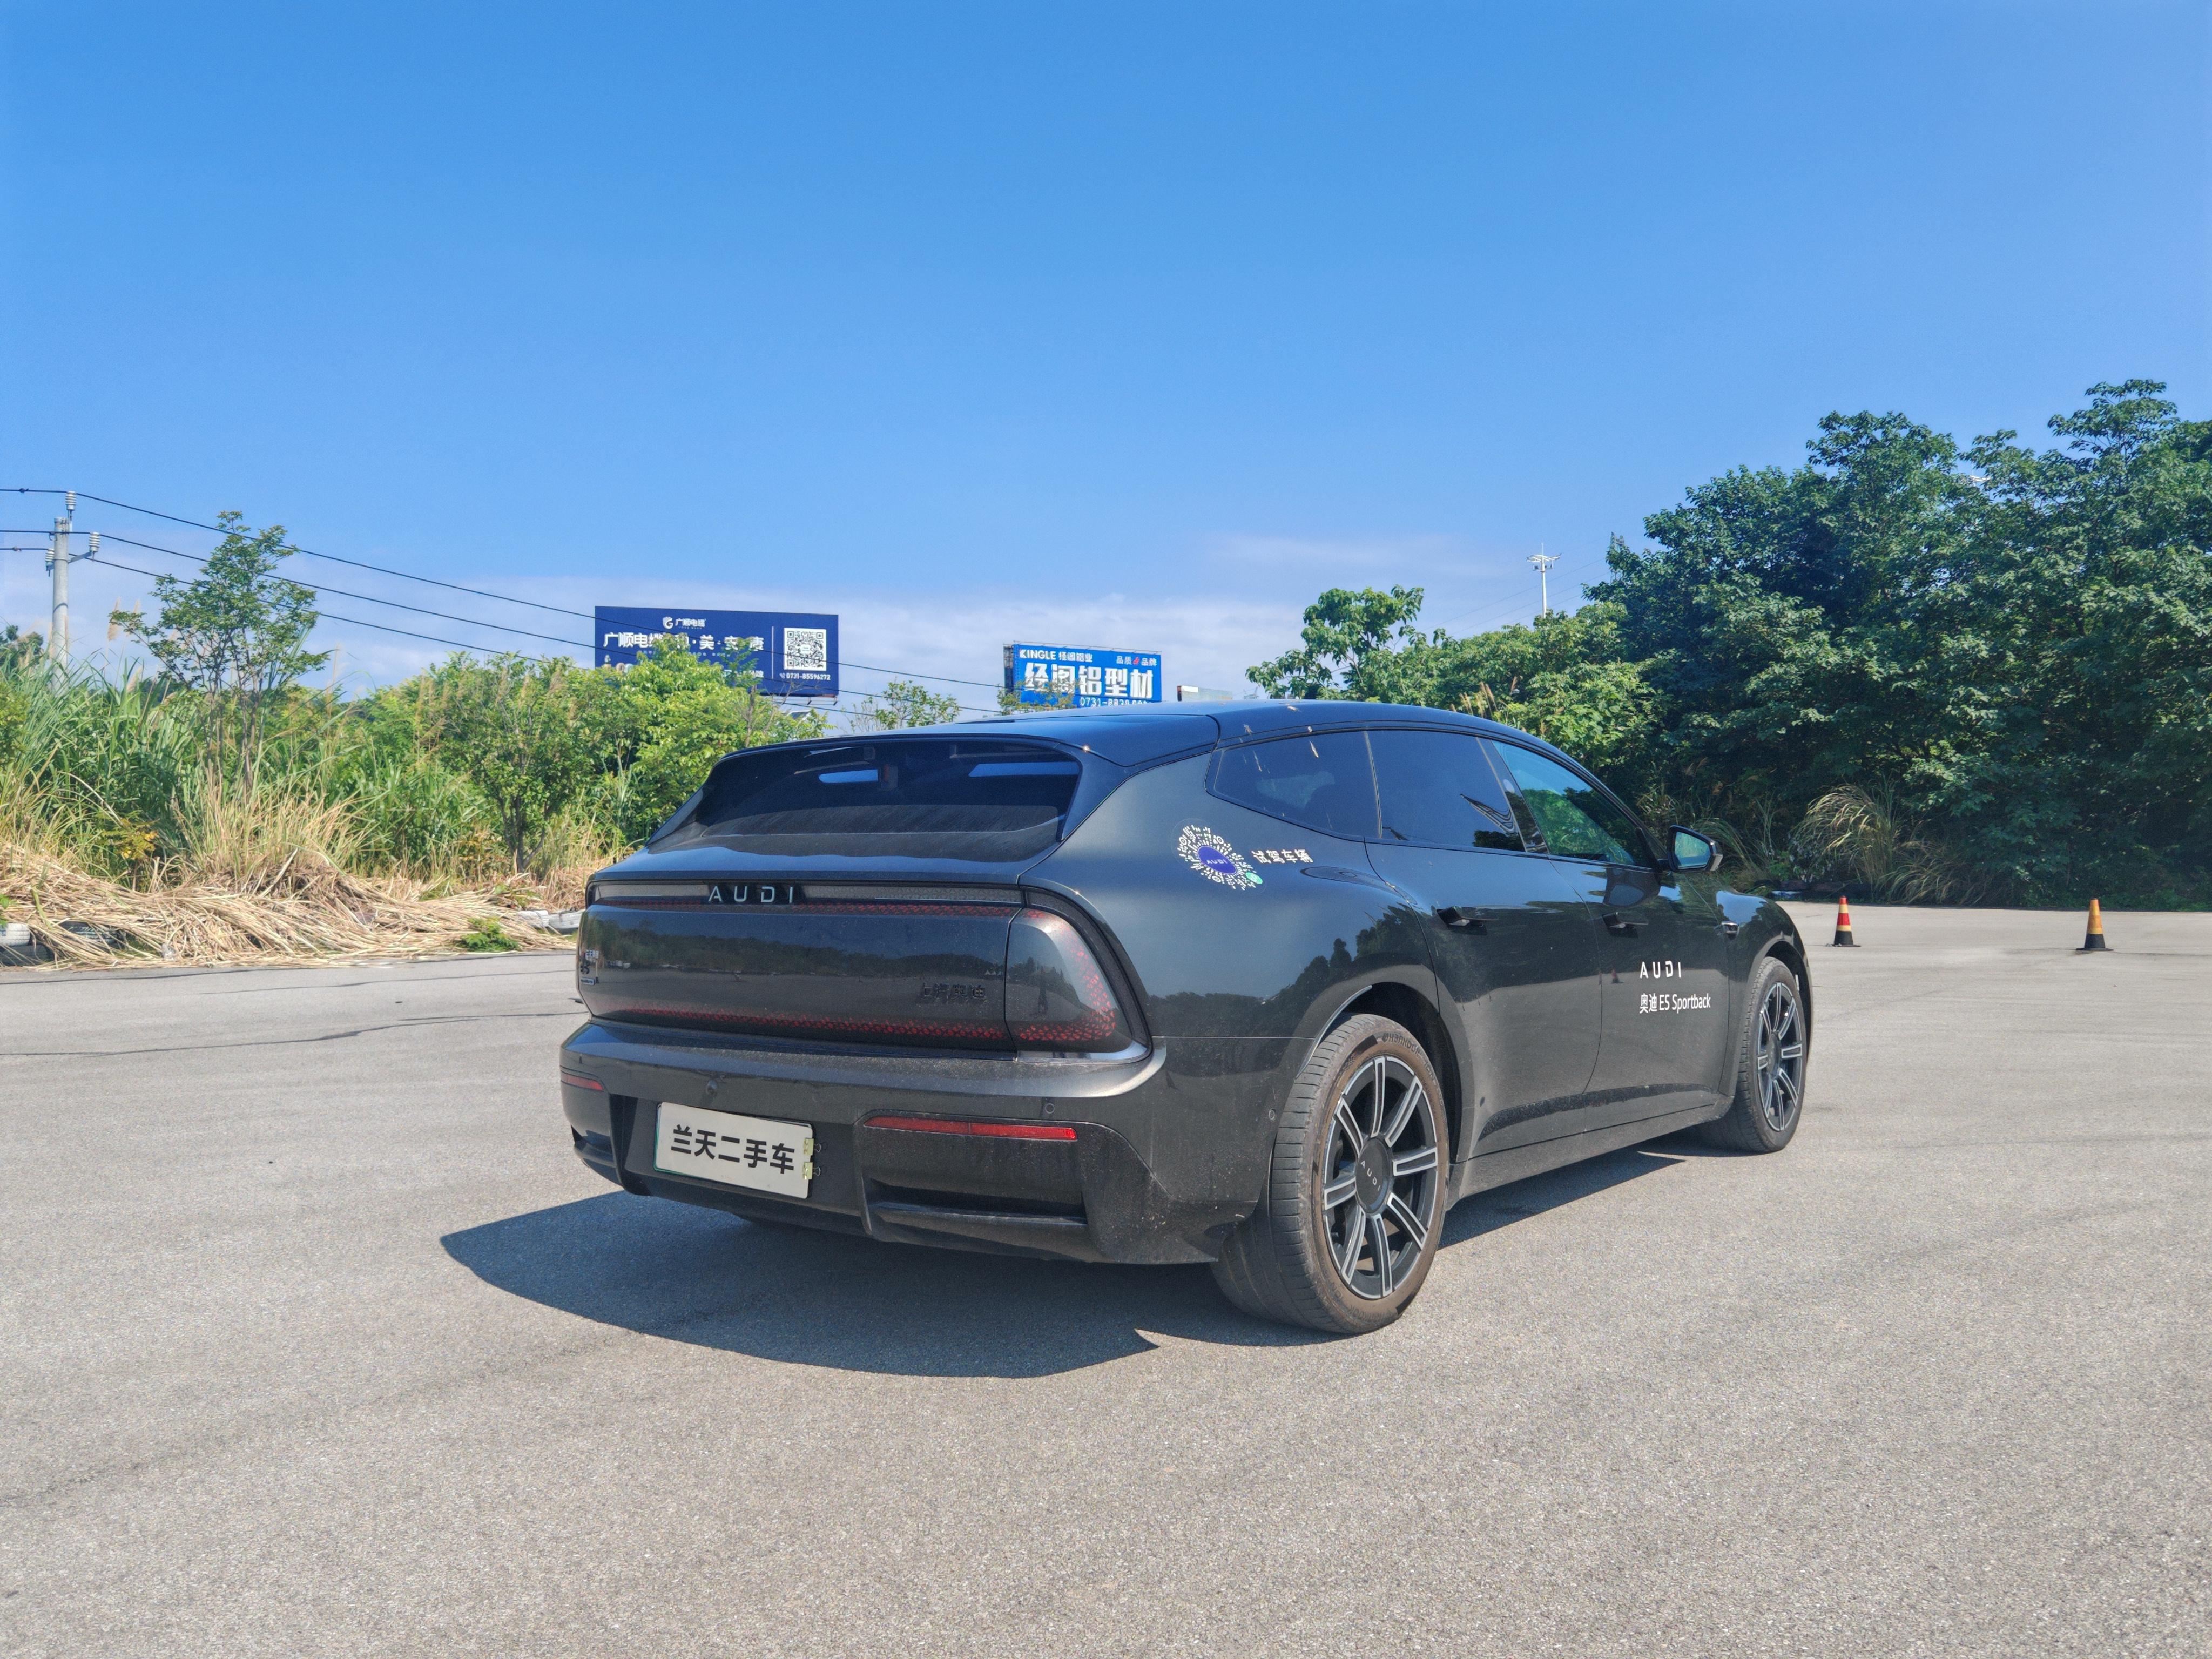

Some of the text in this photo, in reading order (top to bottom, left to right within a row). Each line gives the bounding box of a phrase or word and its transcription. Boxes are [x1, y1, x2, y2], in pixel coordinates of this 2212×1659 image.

[675, 618, 705, 628] 广顺电缆
[1019, 649, 1056, 660] KINGLE
[1141, 658, 1157, 667] 品牌
[786, 672, 831, 680] 0731-85596272
[1251, 849, 1313, 864] 试驾车辆
[708, 886, 794, 903] AUDI
[1640, 960, 1681, 979] AUDI
[918, 982, 986, 1000] 上汽奥迪
[1640, 993, 1711, 1014] 奥迪 E5 Sportback
[671, 1124, 795, 1174] 兰天二手车
[1360, 1160, 1381, 1192] AUDI
